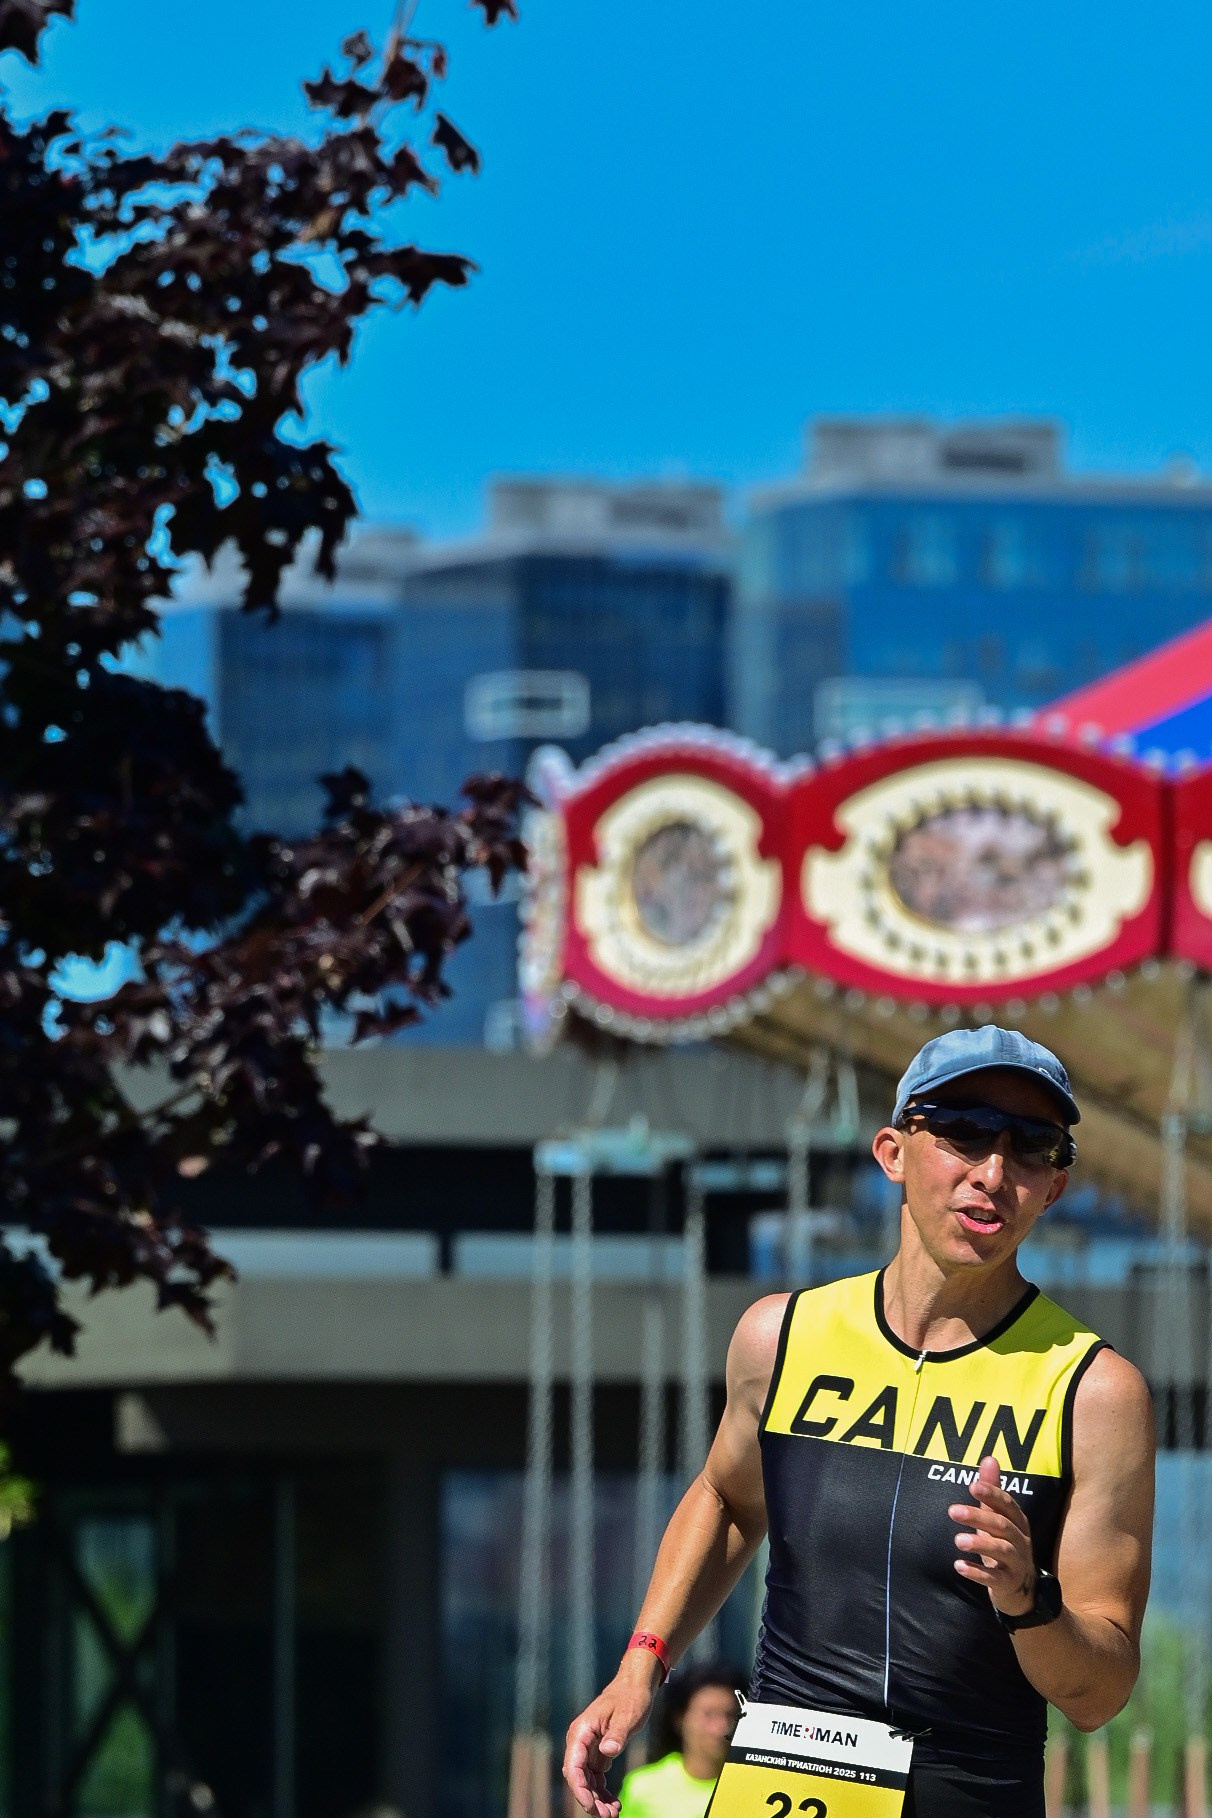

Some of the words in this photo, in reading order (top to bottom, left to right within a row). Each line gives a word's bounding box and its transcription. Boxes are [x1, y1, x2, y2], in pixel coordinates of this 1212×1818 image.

[789, 1374, 1047, 1471] CANN
[927, 1464, 1034, 1496] CANBAL
[638, 1635, 657, 1650] 22
[745, 1752, 787, 1767] КАЗАНСКИЙ
[787, 1759, 833, 1774] ТРИАТЛОН
[833, 1767, 856, 1779] 2025
[859, 1772, 877, 1782] 113
